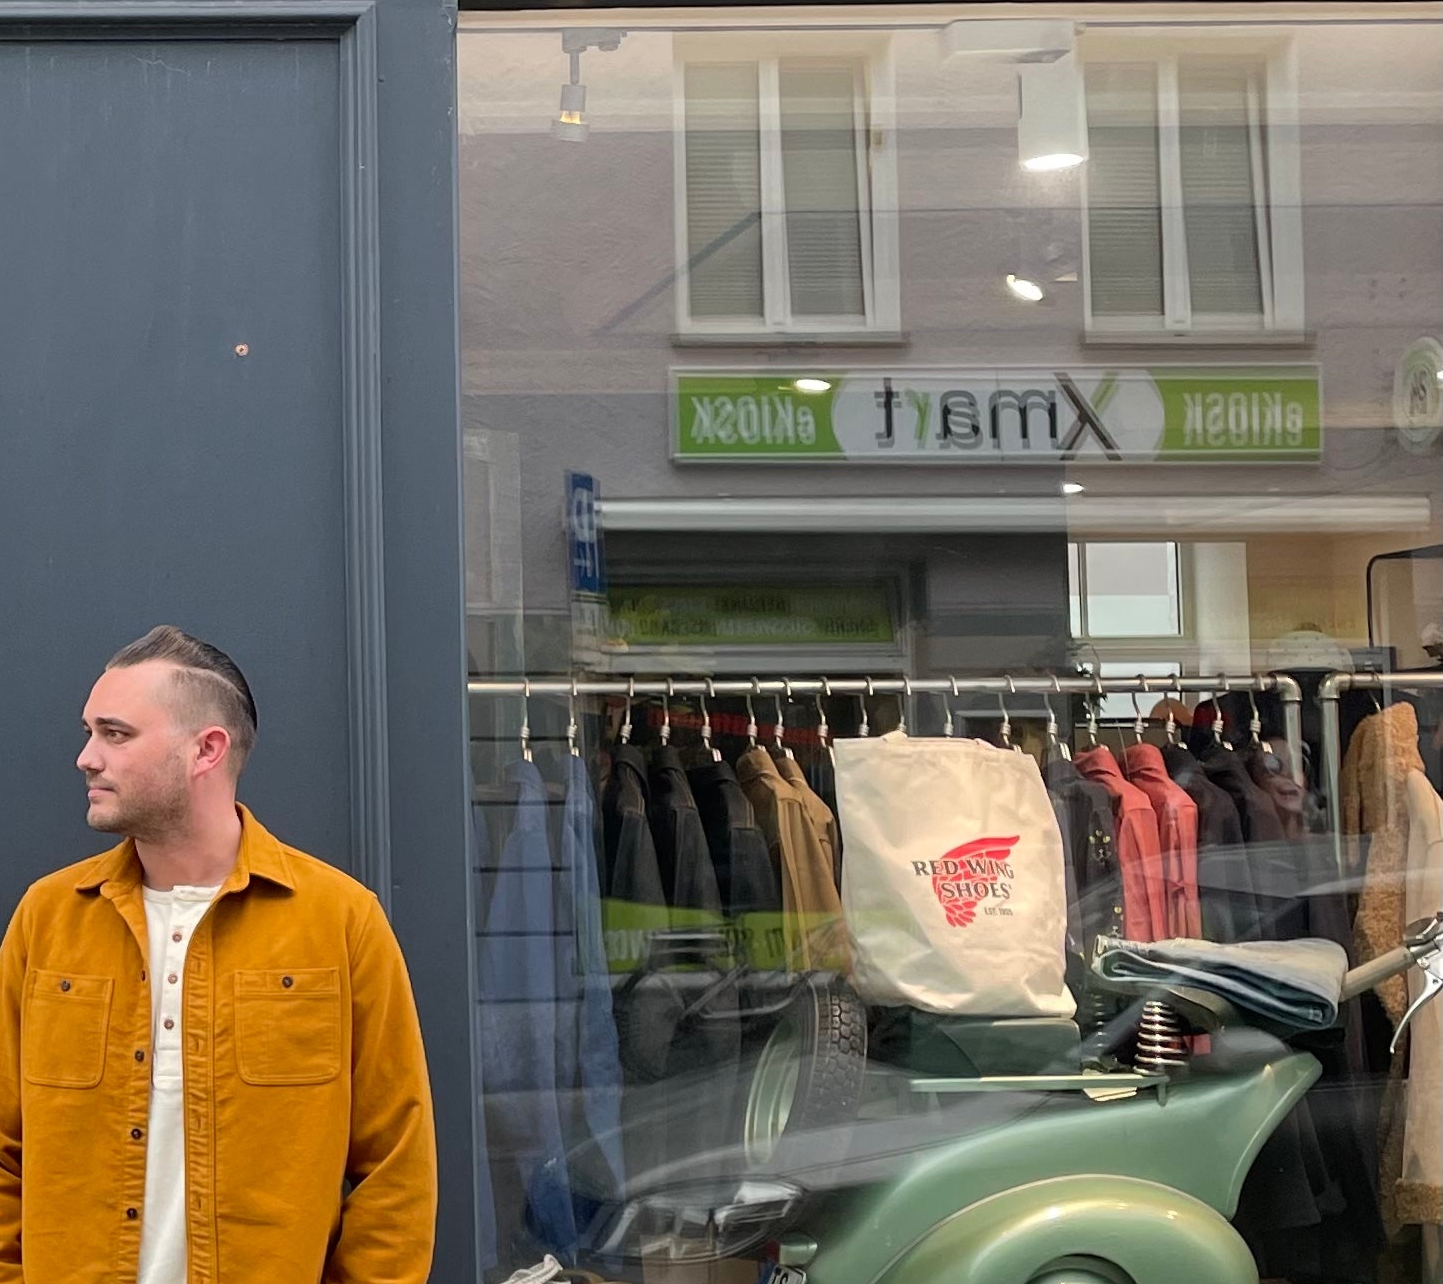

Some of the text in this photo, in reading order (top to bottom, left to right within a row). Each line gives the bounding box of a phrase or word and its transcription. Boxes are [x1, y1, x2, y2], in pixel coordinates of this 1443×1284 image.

[911, 858, 1015, 879] RED WING
[940, 882, 1012, 899] SHOES
